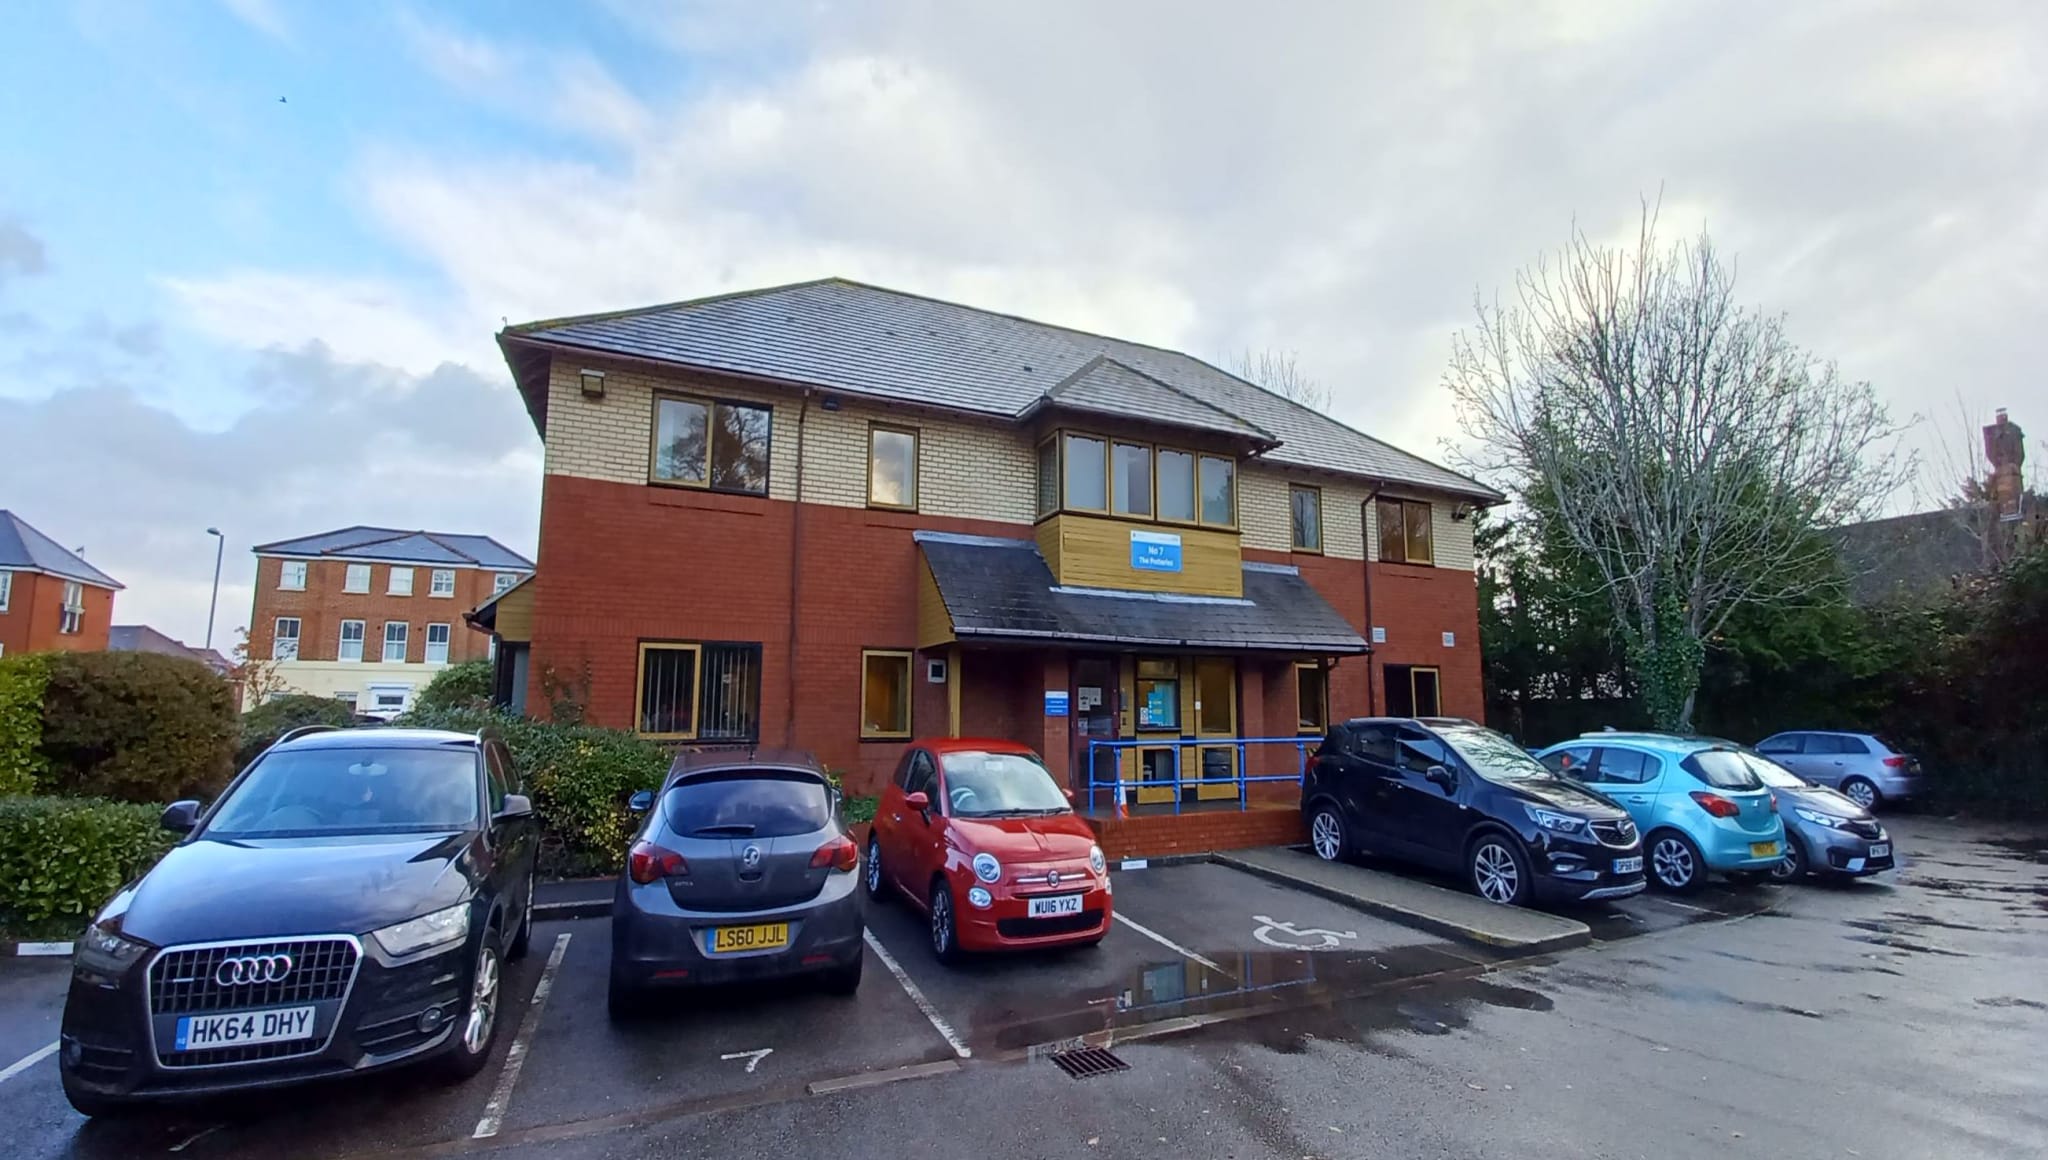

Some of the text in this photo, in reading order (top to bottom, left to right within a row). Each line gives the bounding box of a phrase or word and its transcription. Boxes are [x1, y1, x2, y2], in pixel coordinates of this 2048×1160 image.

[1148, 545, 1164, 556] No 7
[1139, 556, 1149, 564] The
[1035, 898, 1077, 914] WU16 YXZ
[717, 926, 785, 948] LS60 JJL
[192, 1010, 310, 1043] HK64 DHY
